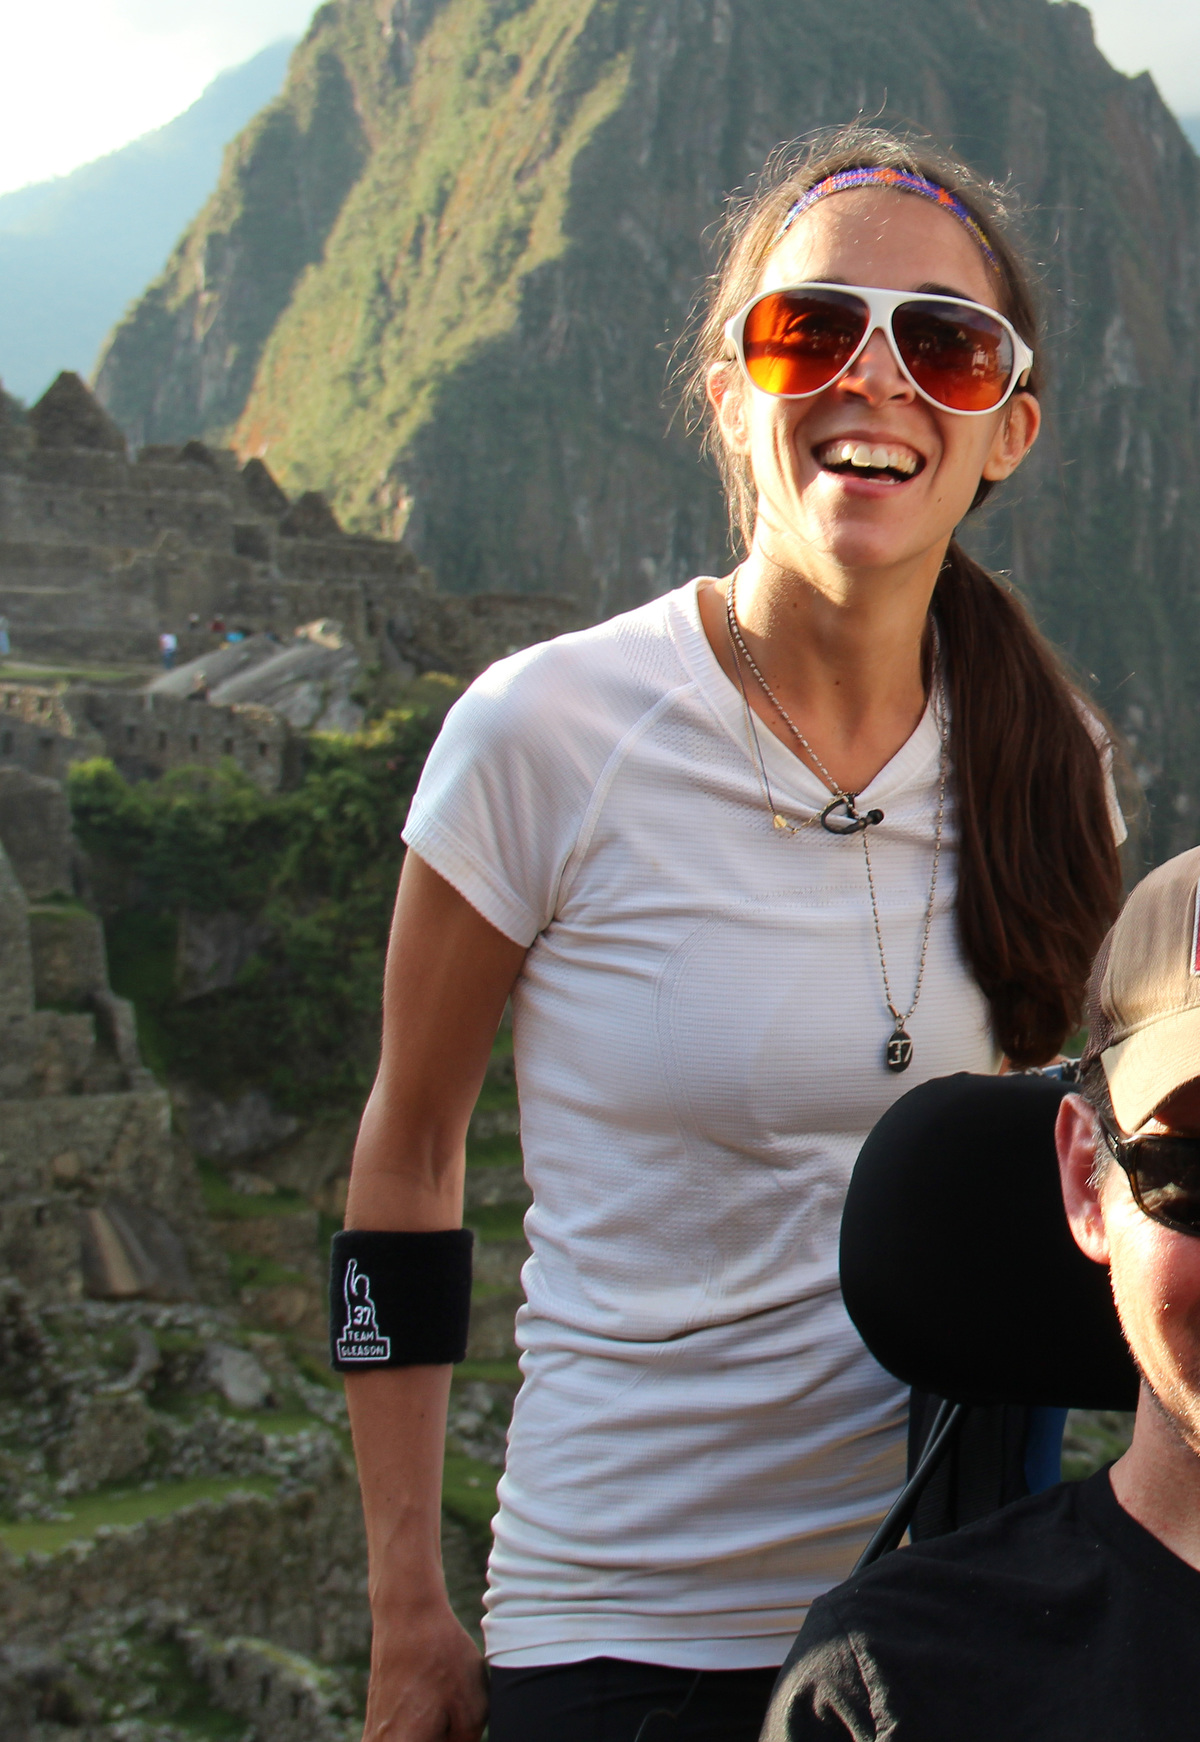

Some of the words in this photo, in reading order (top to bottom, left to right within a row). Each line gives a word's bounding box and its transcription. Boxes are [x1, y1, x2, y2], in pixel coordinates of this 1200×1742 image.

[888, 1040, 913, 1065] 37
[353, 1305, 371, 1326] 37
[347, 1330, 375, 1342] TEAM
[341, 1345, 385, 1357] GLEASON
